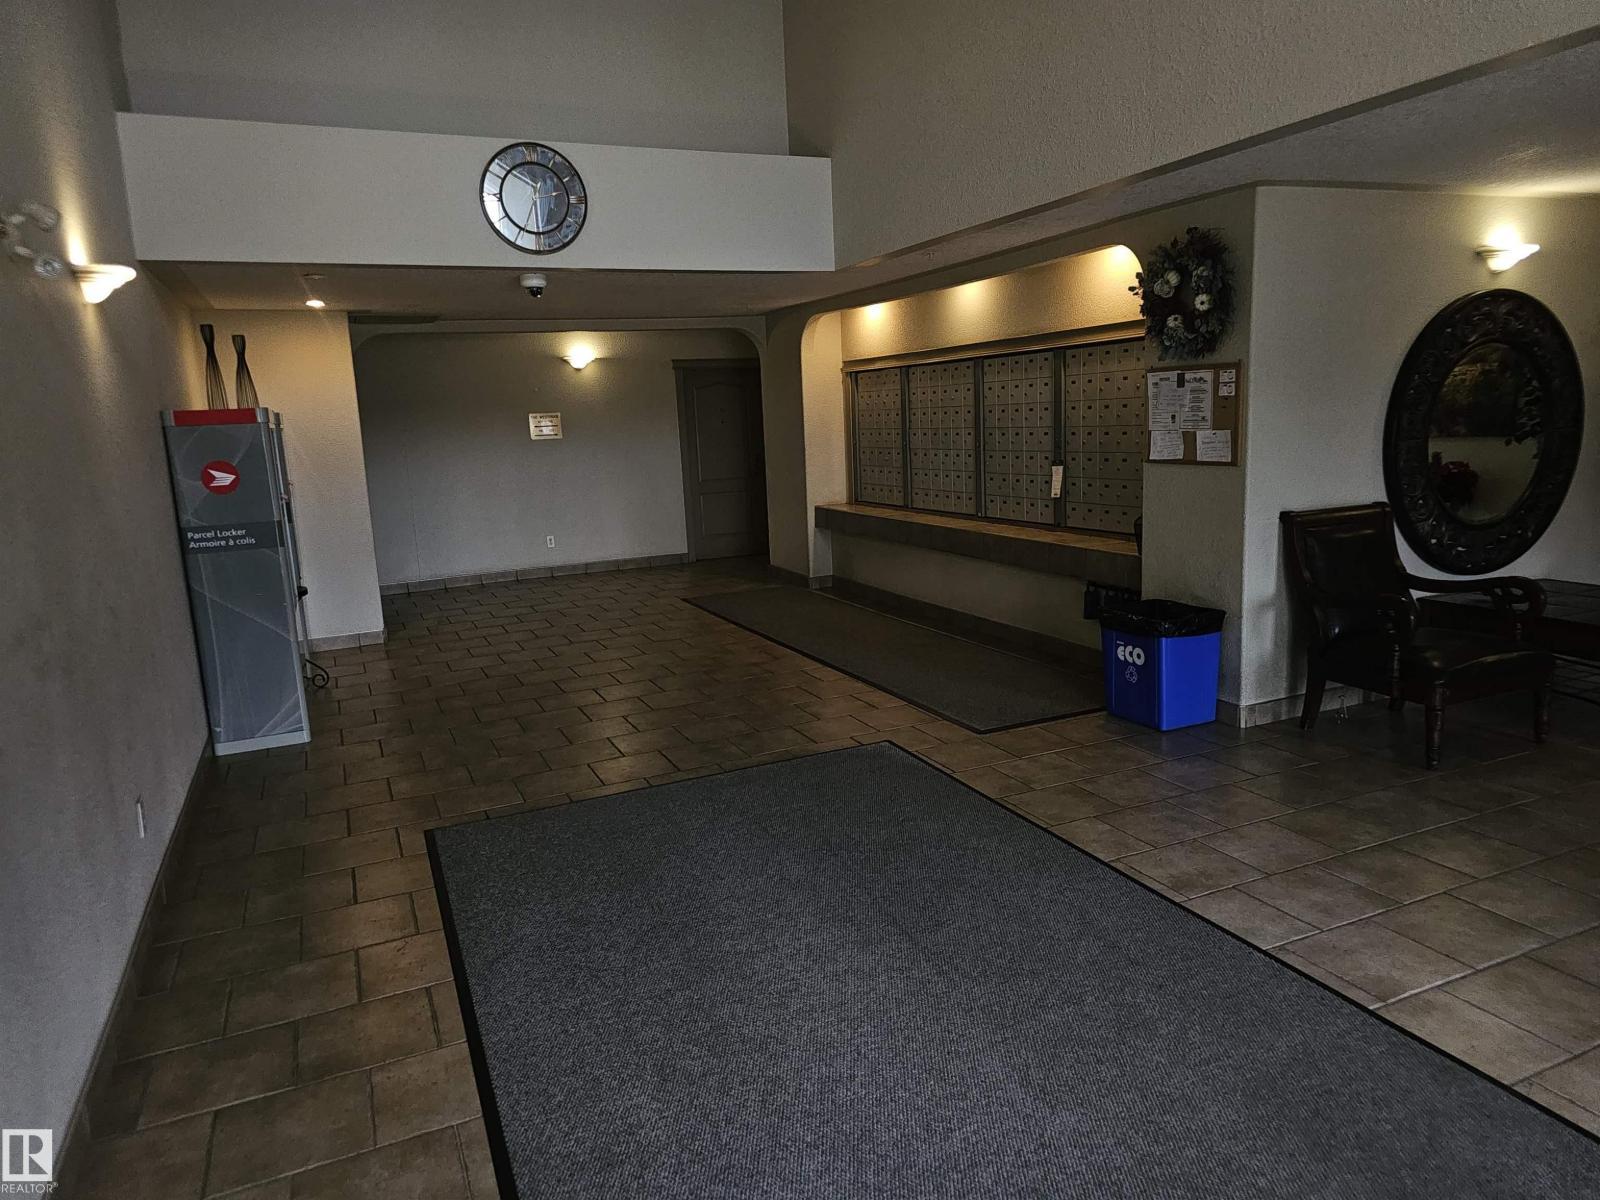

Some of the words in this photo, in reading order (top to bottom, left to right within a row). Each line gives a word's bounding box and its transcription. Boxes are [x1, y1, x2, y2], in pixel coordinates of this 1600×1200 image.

[187, 530, 215, 539] Parcel
[217, 529, 247, 537] Locker
[189, 540, 226, 548] Armoire
[228, 538, 234, 546] à
[236, 536, 256, 545] colis
